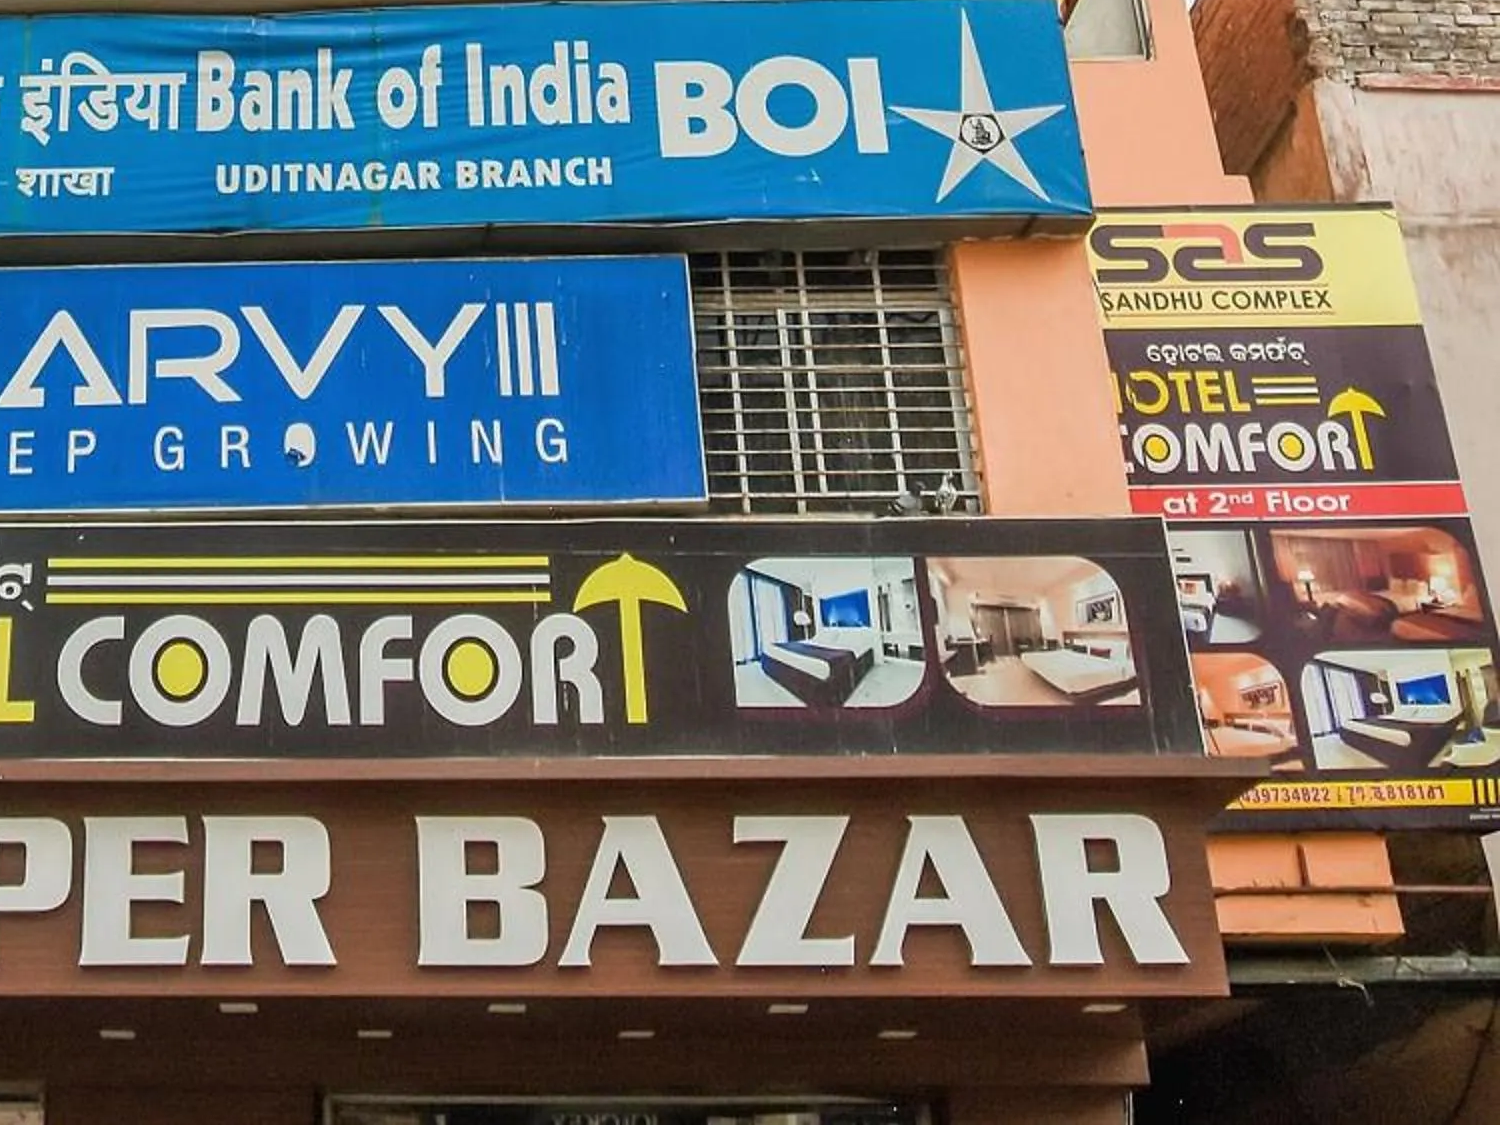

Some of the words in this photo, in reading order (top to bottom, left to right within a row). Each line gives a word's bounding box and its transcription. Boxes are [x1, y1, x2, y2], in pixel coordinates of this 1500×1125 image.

[19, 51, 188, 147] इंडिया
[195, 47, 356, 133] Bank
[376, 43, 443, 130] of
[465, 39, 632, 128] India
[653, 55, 890, 159] BOI
[15, 166, 116, 198] शाखा
[215, 161, 442, 195] UDITNAGAR
[455, 157, 614, 191] BRANCH
[1100, 291, 1203, 312] SANDHU
[1211, 290, 1333, 310] COMPLEX
[153, 418, 569, 471] GROWING
[1121, 386, 1387, 475] OMFORT
[1163, 493, 1199, 514] at
[1208, 492, 1255, 515] 2nd
[1266, 491, 1352, 513] Floor
[57, 553, 688, 727] COMFORT
[414, 813, 1192, 967] BAZAR
